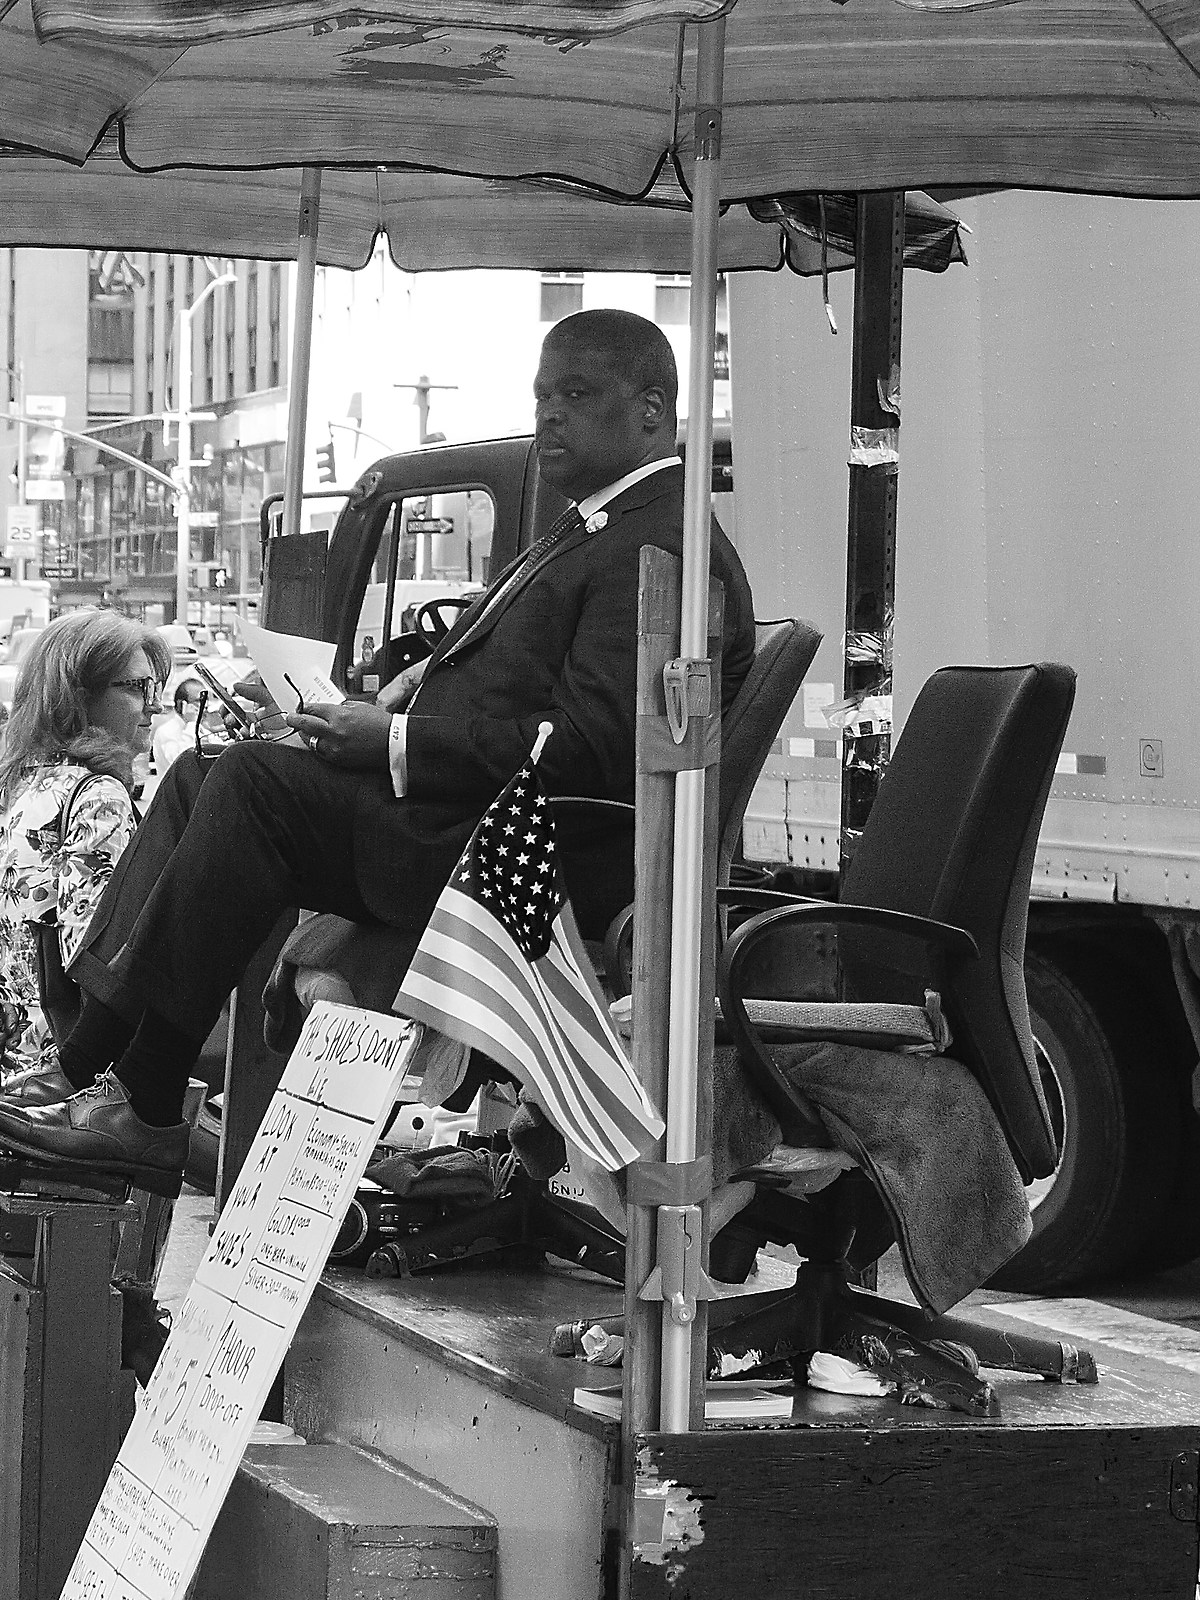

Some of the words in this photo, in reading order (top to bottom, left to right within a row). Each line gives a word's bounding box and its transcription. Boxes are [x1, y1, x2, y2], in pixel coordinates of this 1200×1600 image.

[10, 526, 32, 540] 25
[261, 1102, 299, 1142] LOOK
[254, 1146, 279, 1177] AT
[208, 1225, 252, 1269] SHOE'S
